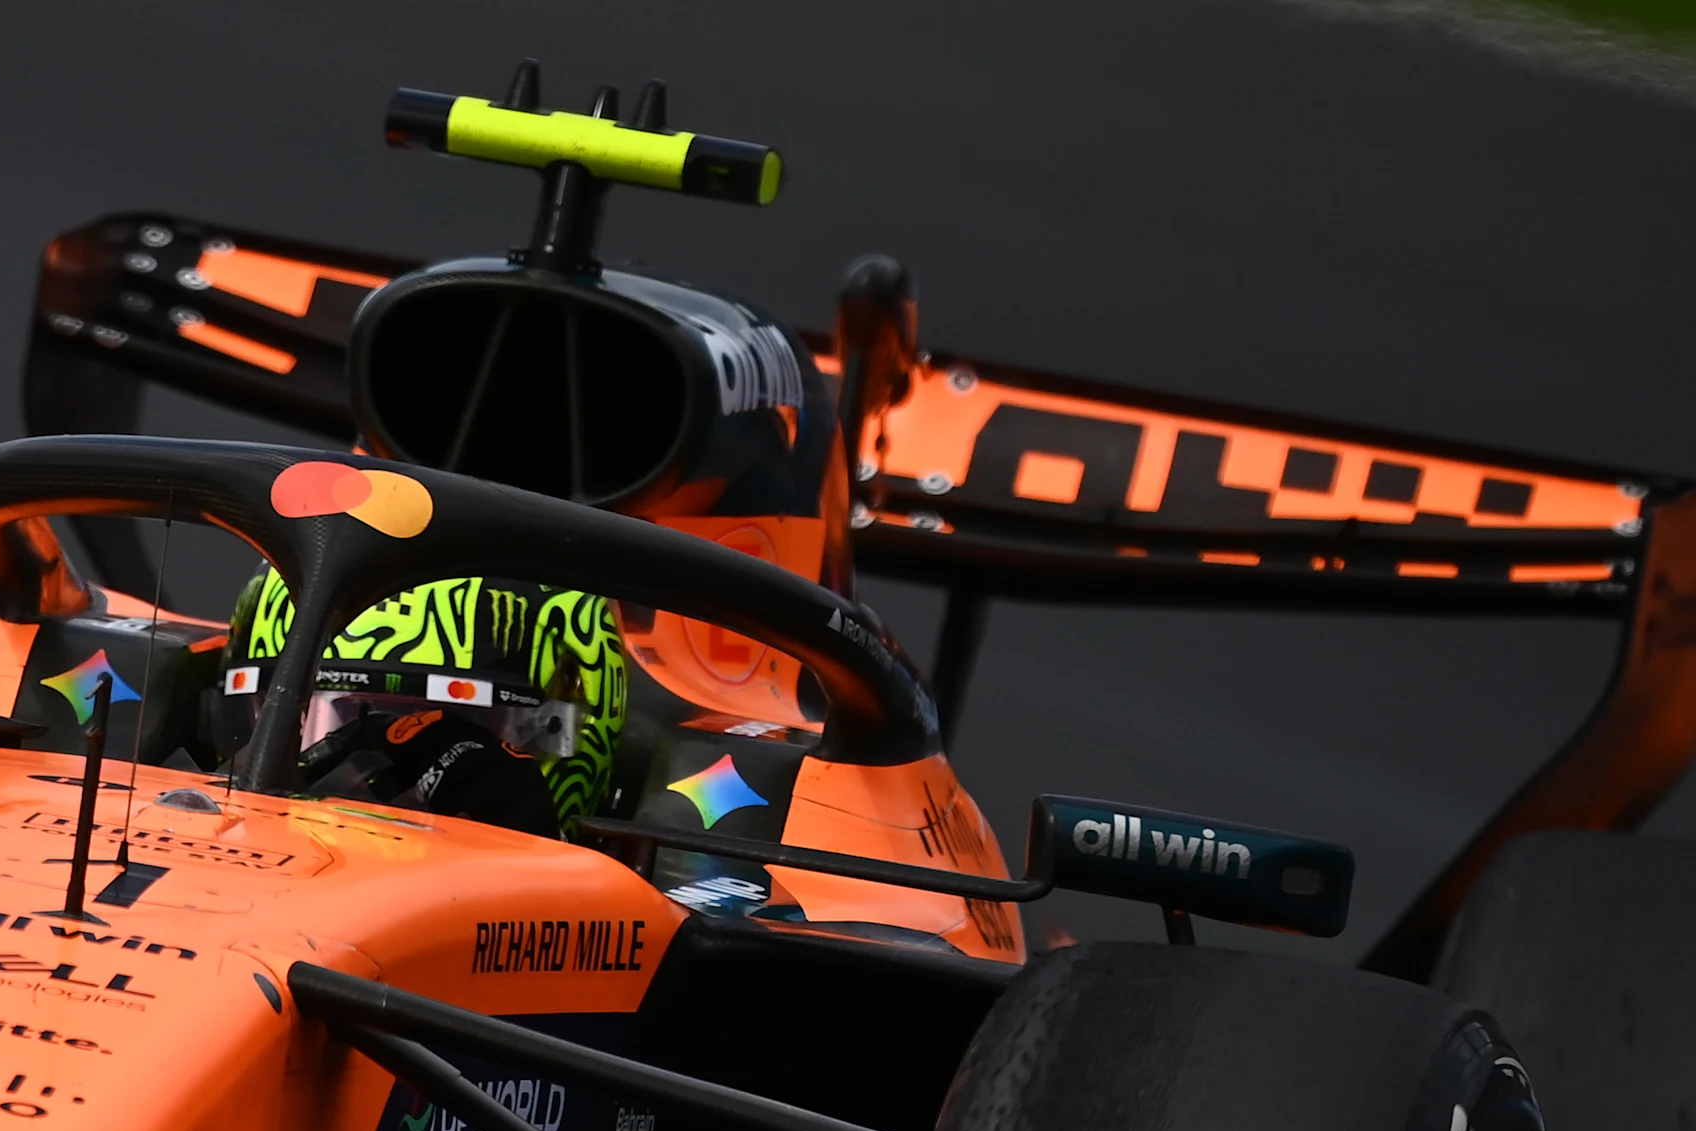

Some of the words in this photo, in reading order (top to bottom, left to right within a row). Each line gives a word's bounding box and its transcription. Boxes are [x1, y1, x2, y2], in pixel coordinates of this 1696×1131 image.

[188, 853, 278, 870] STAY
[1072, 813, 1142, 862] all
[1150, 828, 1252, 879] win
[48, 925, 198, 961] win
[471, 920, 570, 974] RICHARD
[572, 920, 646, 972] MILLE
